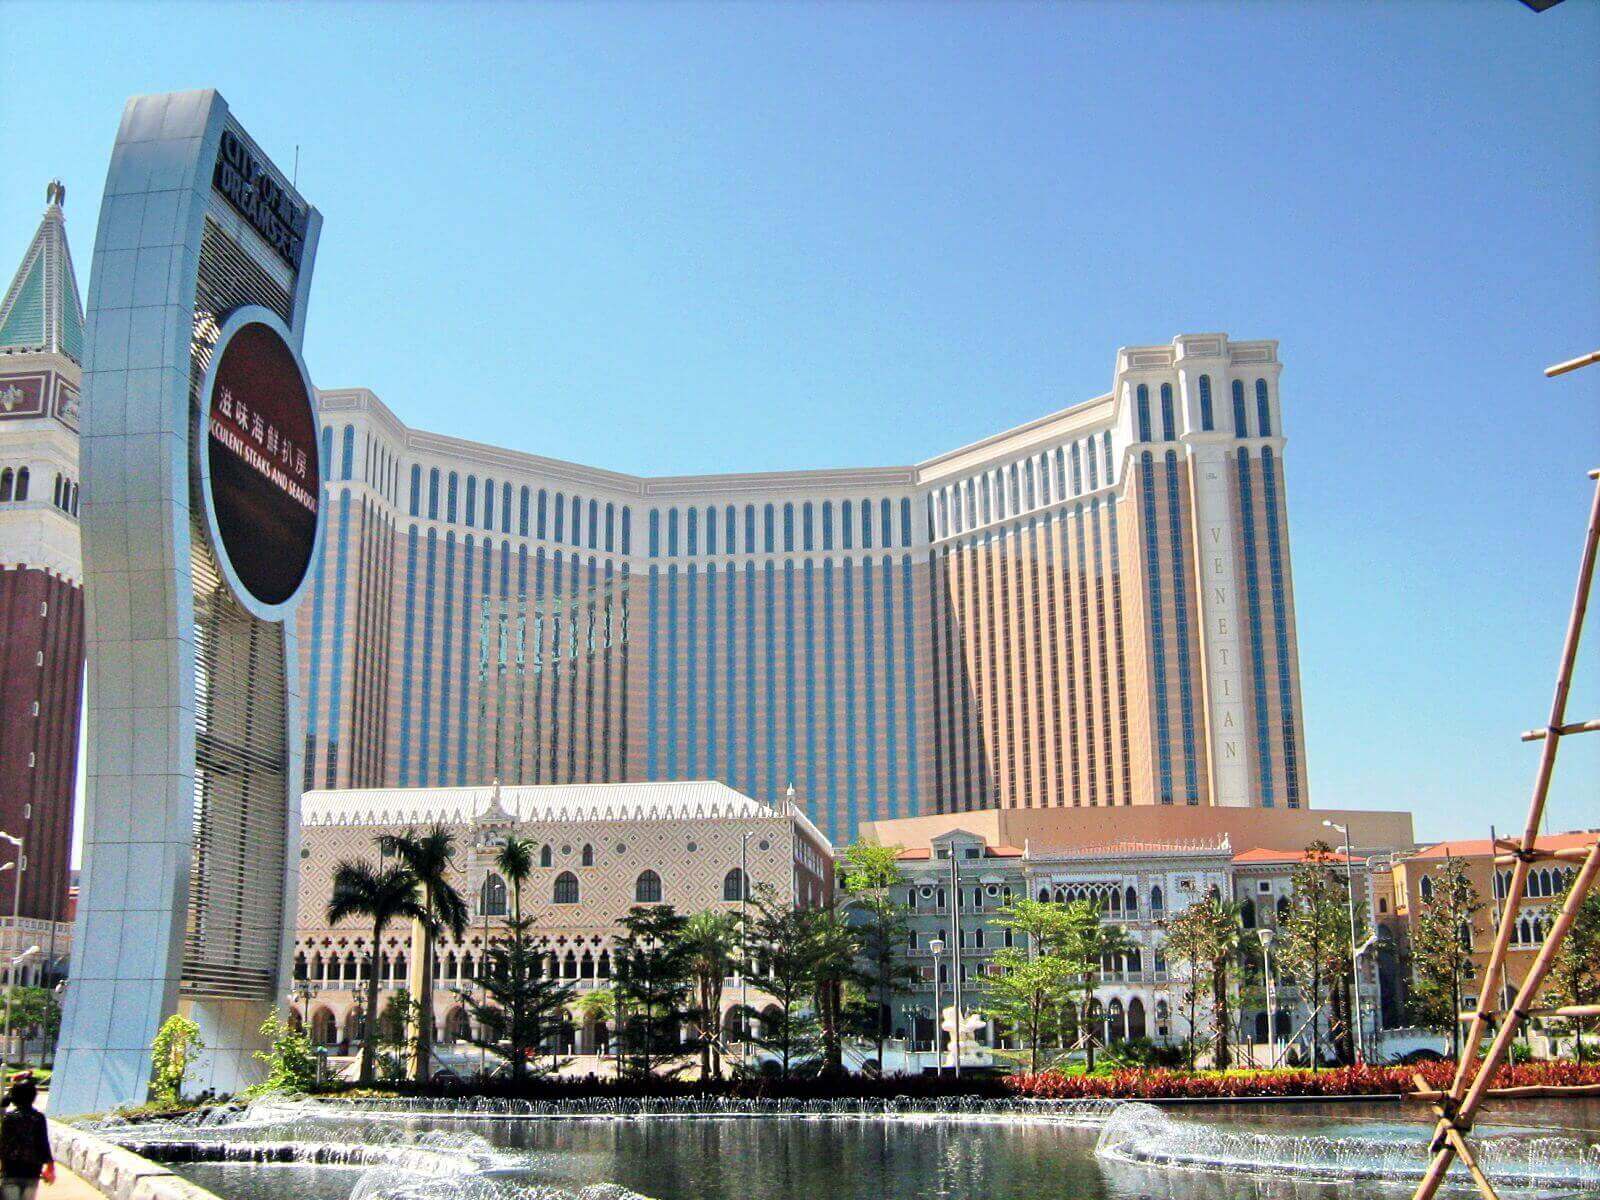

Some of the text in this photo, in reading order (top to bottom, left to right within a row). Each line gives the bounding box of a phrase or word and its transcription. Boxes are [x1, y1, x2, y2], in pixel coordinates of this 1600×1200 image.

[221, 161, 276, 241] DREAMS
[224, 136, 280, 207] CITY OF
[245, 446, 271, 478] STEAKS
[271, 467, 288, 491] AND
[1211, 527, 1237, 759] VENETIAN
